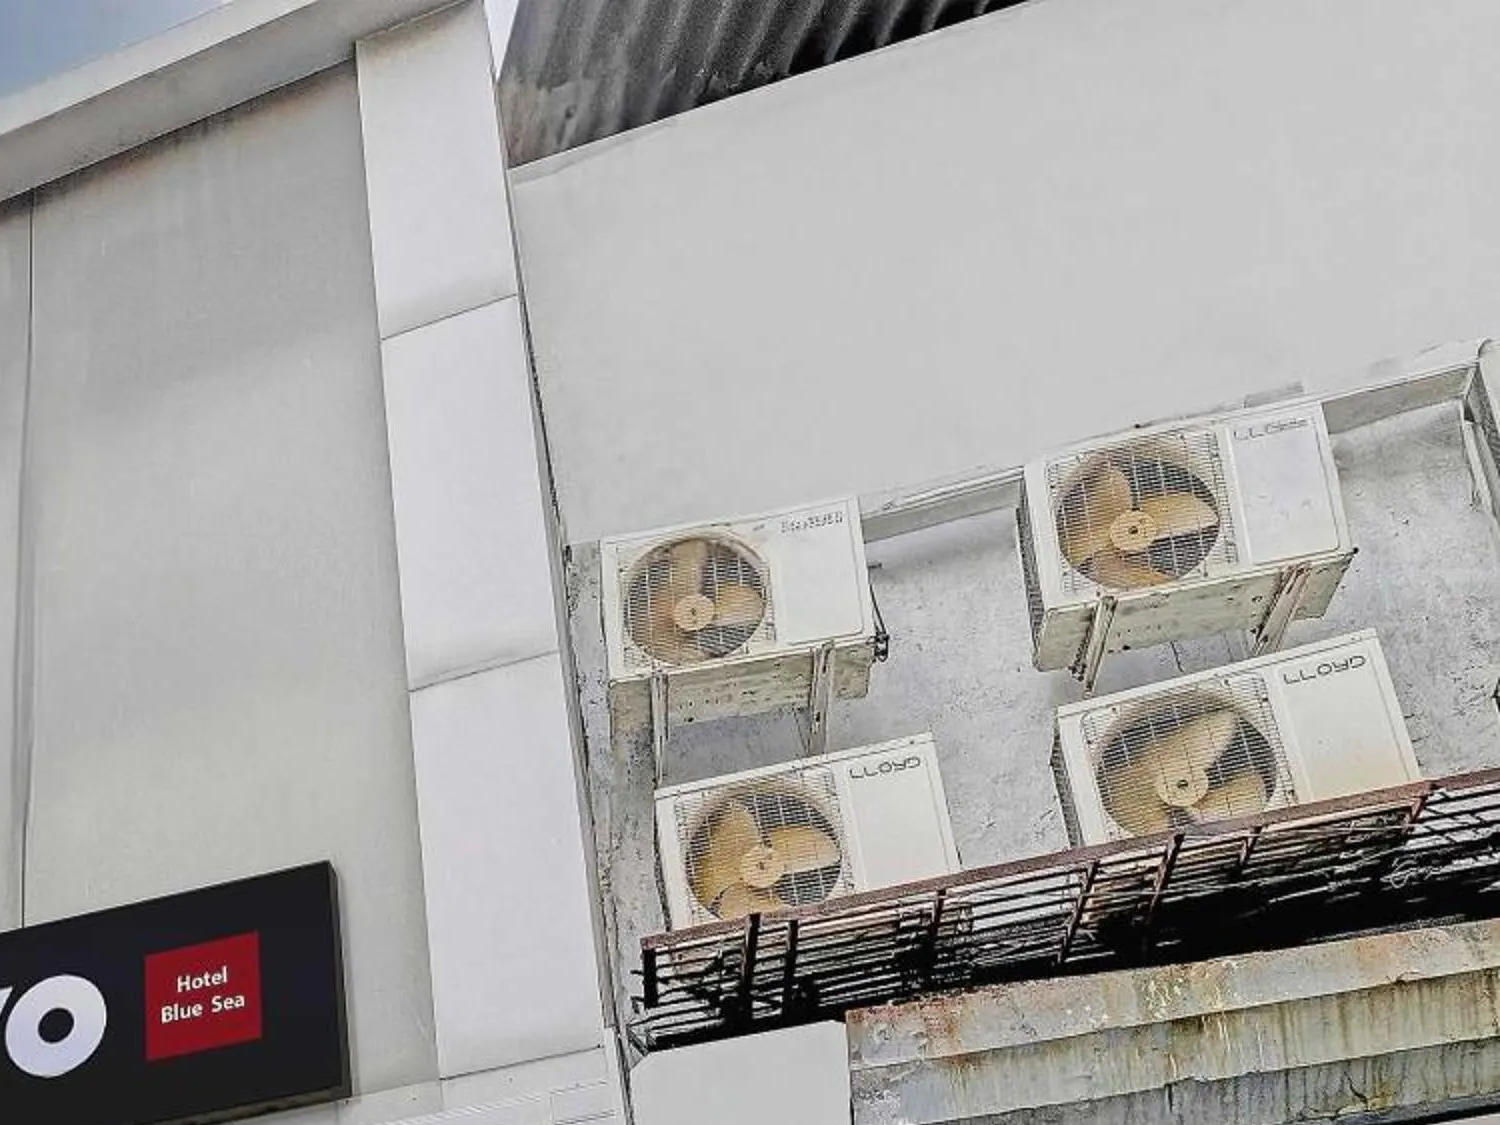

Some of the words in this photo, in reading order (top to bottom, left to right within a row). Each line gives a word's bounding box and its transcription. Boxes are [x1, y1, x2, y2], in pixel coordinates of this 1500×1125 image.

[1283, 655, 1366, 684] LLOYD
[849, 756, 921, 779] LLOYD
[177, 965, 228, 993] Hotel
[161, 1003, 203, 1025] Blue
[211, 994, 246, 1013] Sea
